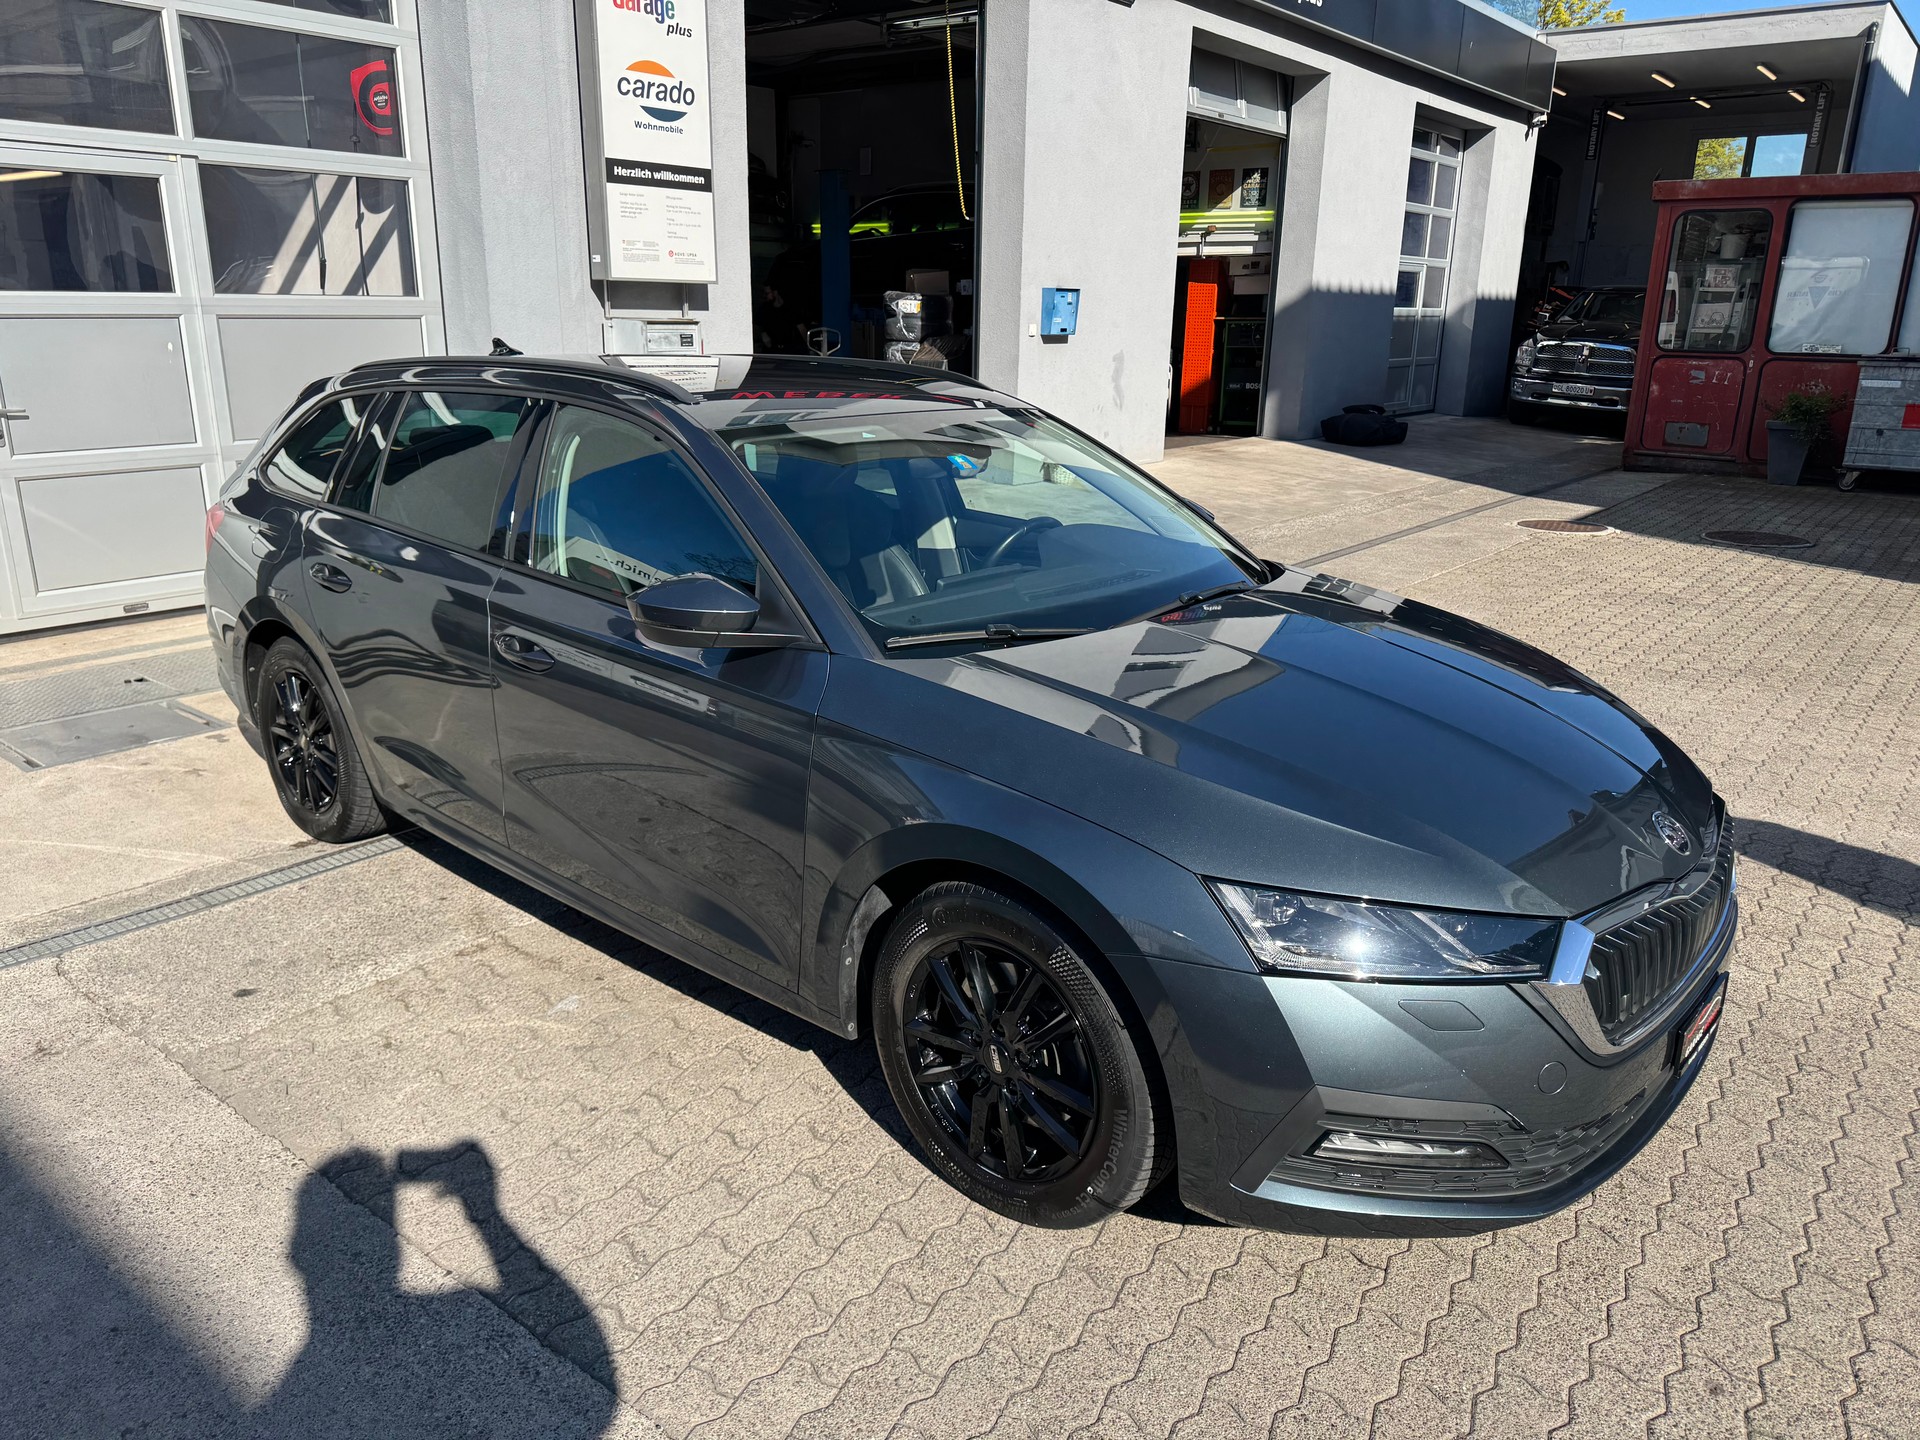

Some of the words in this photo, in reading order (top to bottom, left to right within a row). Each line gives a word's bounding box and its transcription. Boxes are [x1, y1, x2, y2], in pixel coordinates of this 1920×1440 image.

[666, 22, 693, 38] plus
[617, 76, 696, 106] carado
[634, 120, 684, 135] Wohnmobile
[613, 165, 652, 179] Herzlich
[652, 172, 705, 185] willkommen
